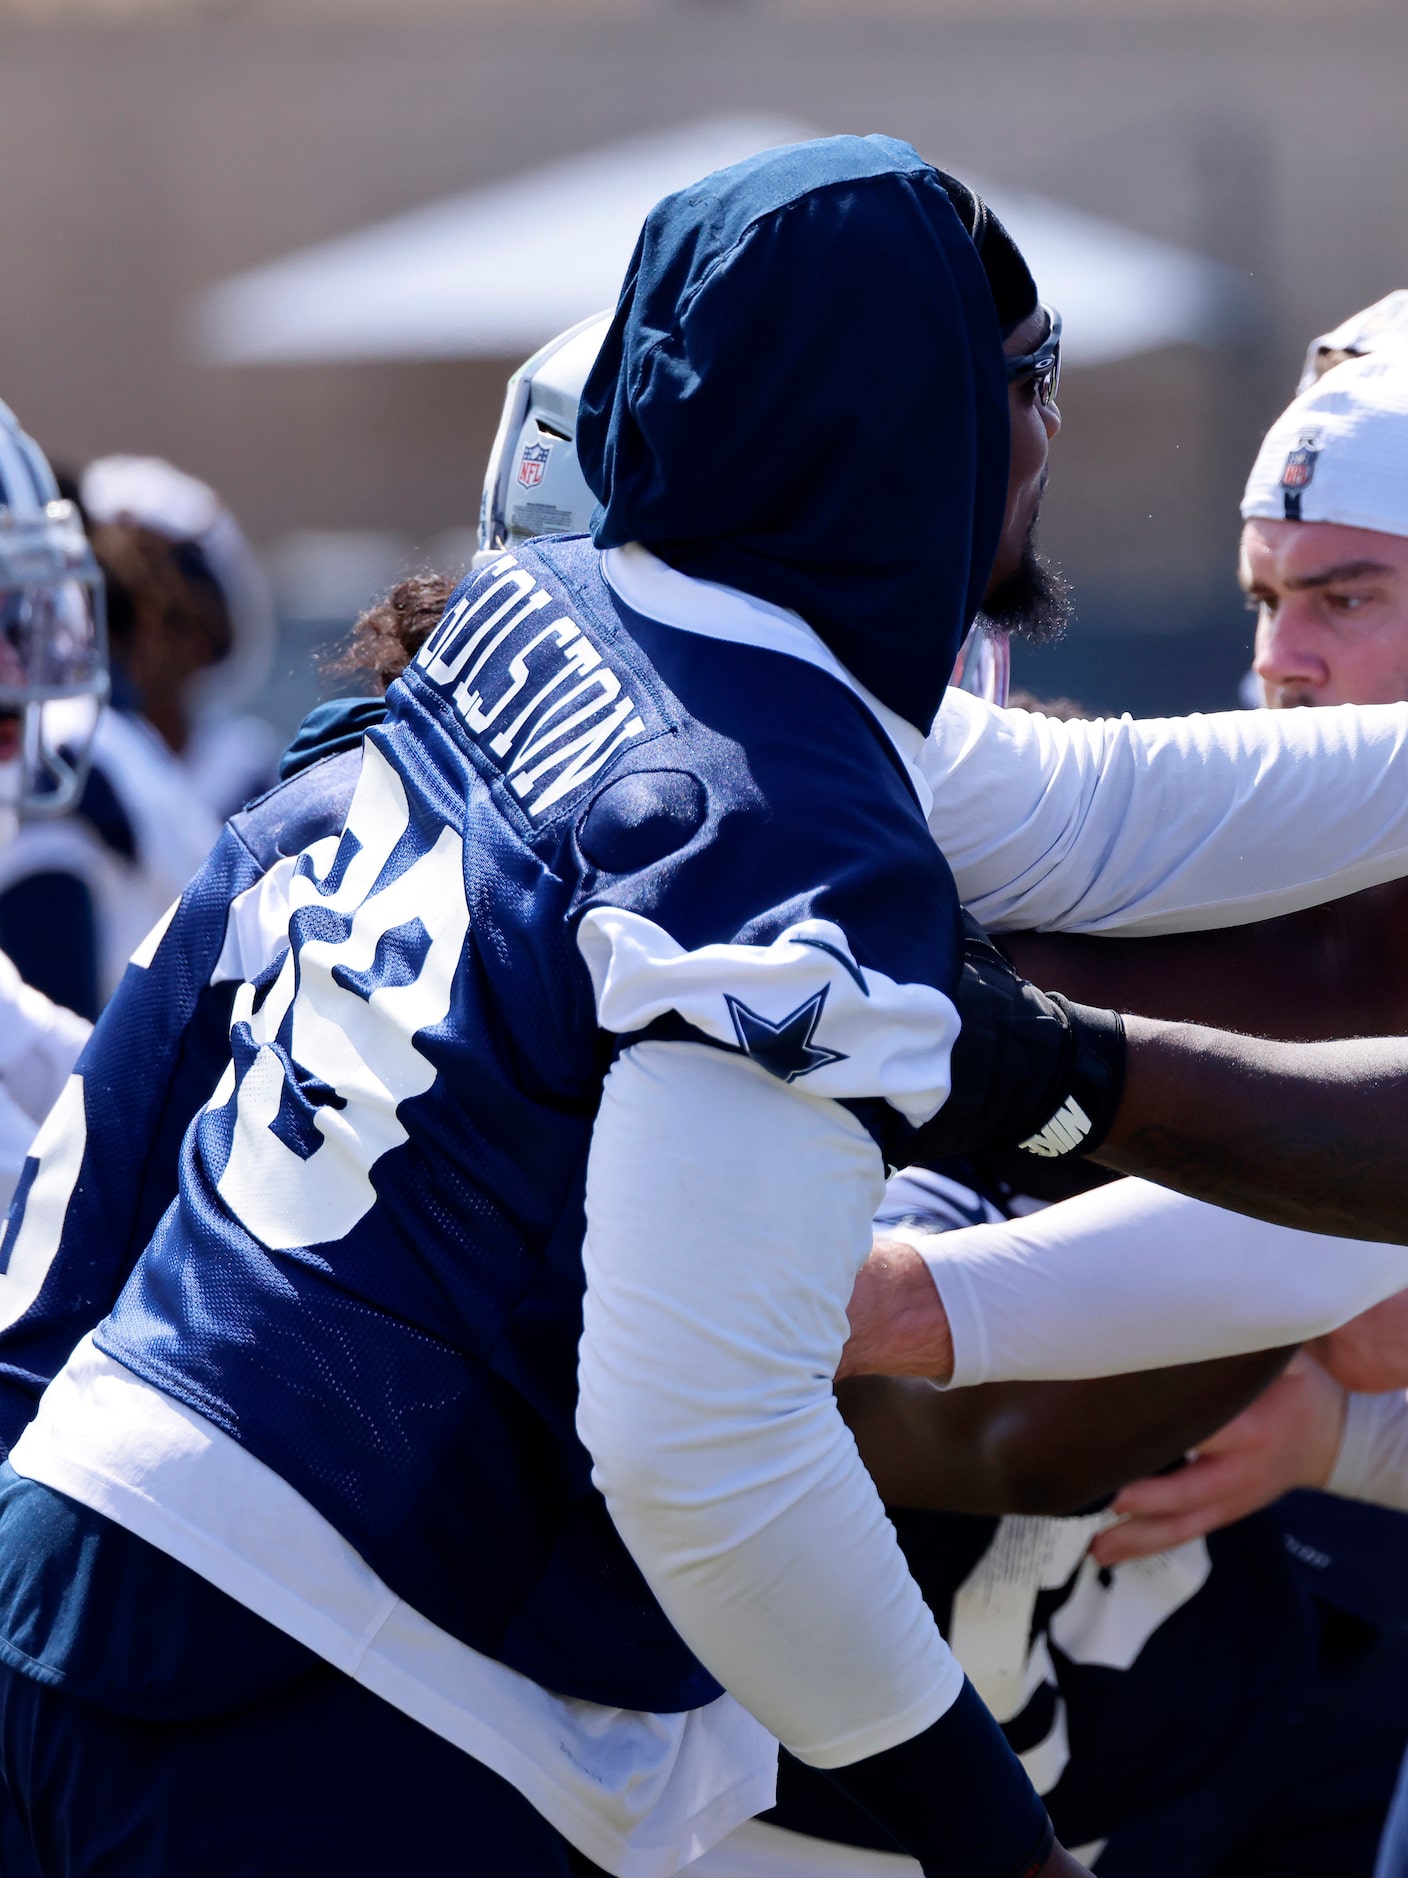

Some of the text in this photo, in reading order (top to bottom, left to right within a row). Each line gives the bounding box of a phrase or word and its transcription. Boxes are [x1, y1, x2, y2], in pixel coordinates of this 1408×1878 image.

[519, 462, 541, 485] NFL
[416, 554, 646, 817] GOLSTON
[1018, 1094, 1092, 1158] NIKE
